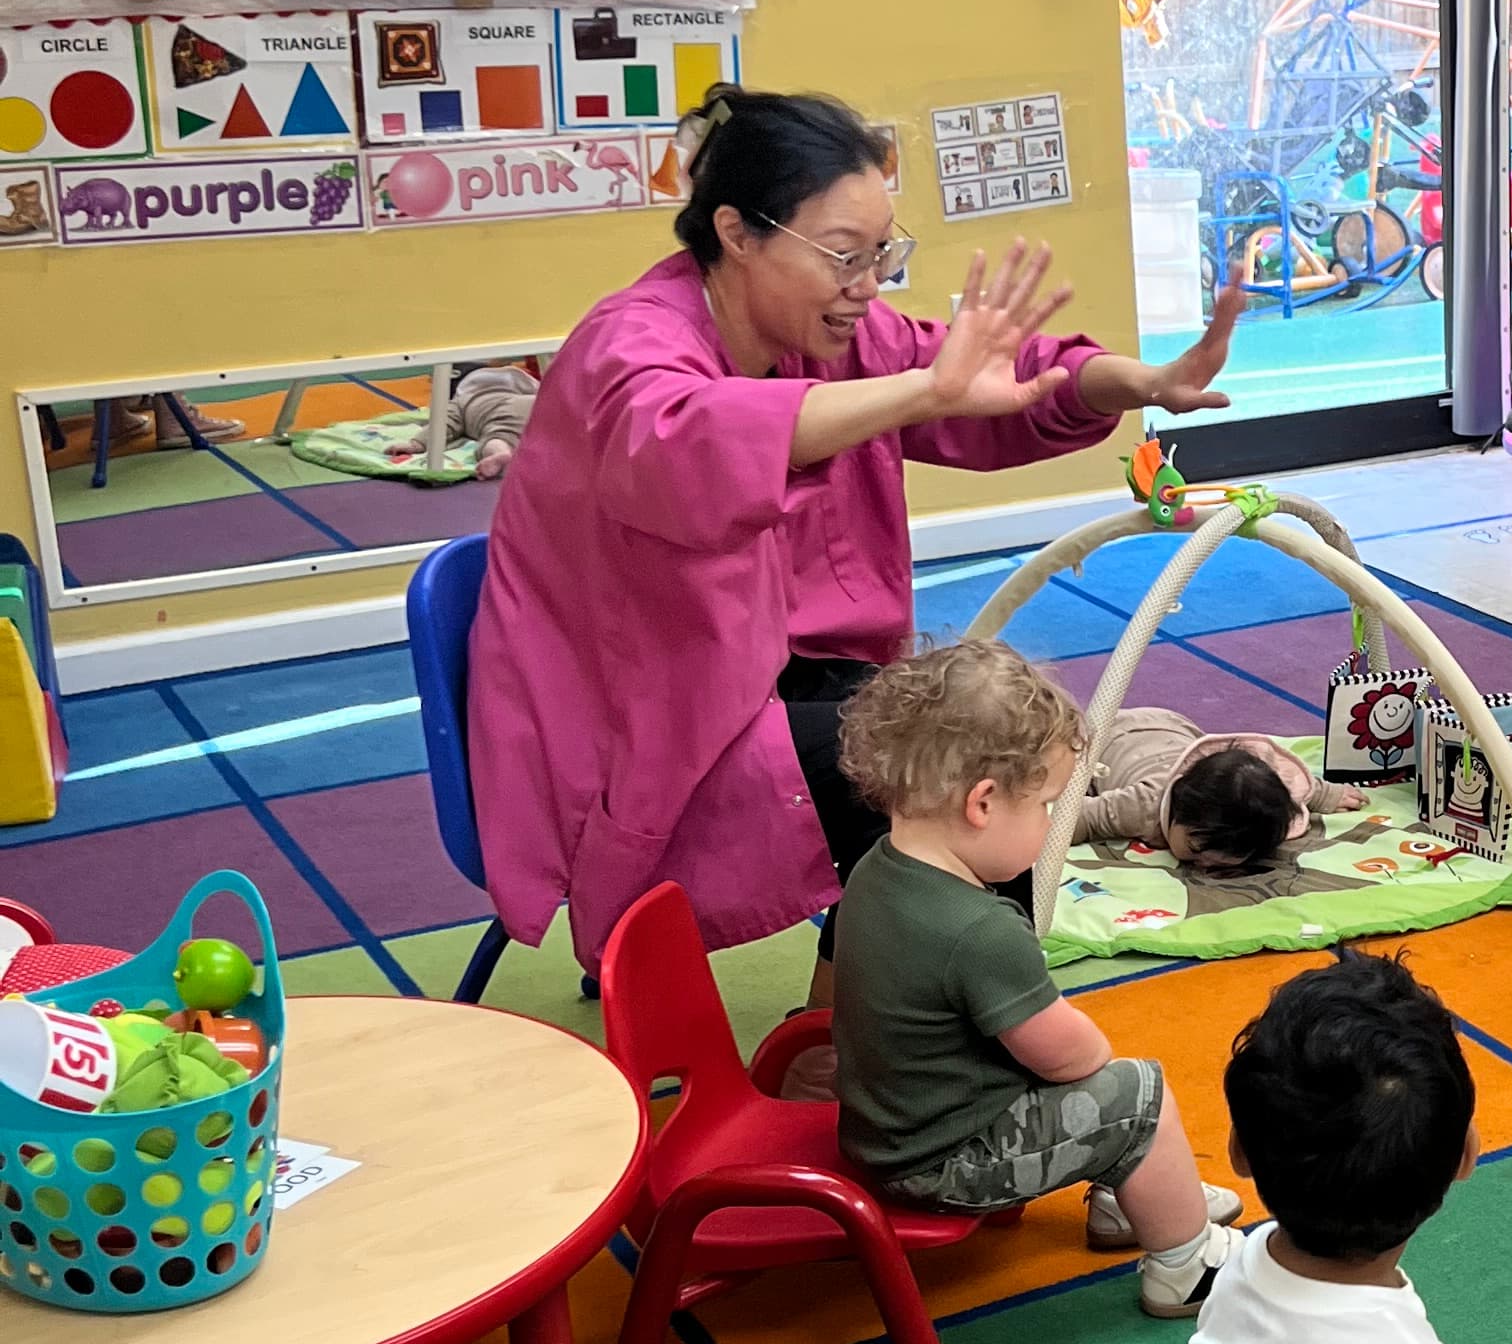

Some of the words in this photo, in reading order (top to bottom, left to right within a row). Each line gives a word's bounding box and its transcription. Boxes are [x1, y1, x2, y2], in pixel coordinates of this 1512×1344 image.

[632, 11, 725, 27] RECTANGLE
[468, 25, 536, 40] SQUARE
[40, 38, 109, 54] CIRCLE
[262, 36, 348, 52] TRIANGLE
[457, 154, 579, 211] pink
[134, 169, 309, 229] purple
[274, 1166, 323, 1194] OOD
